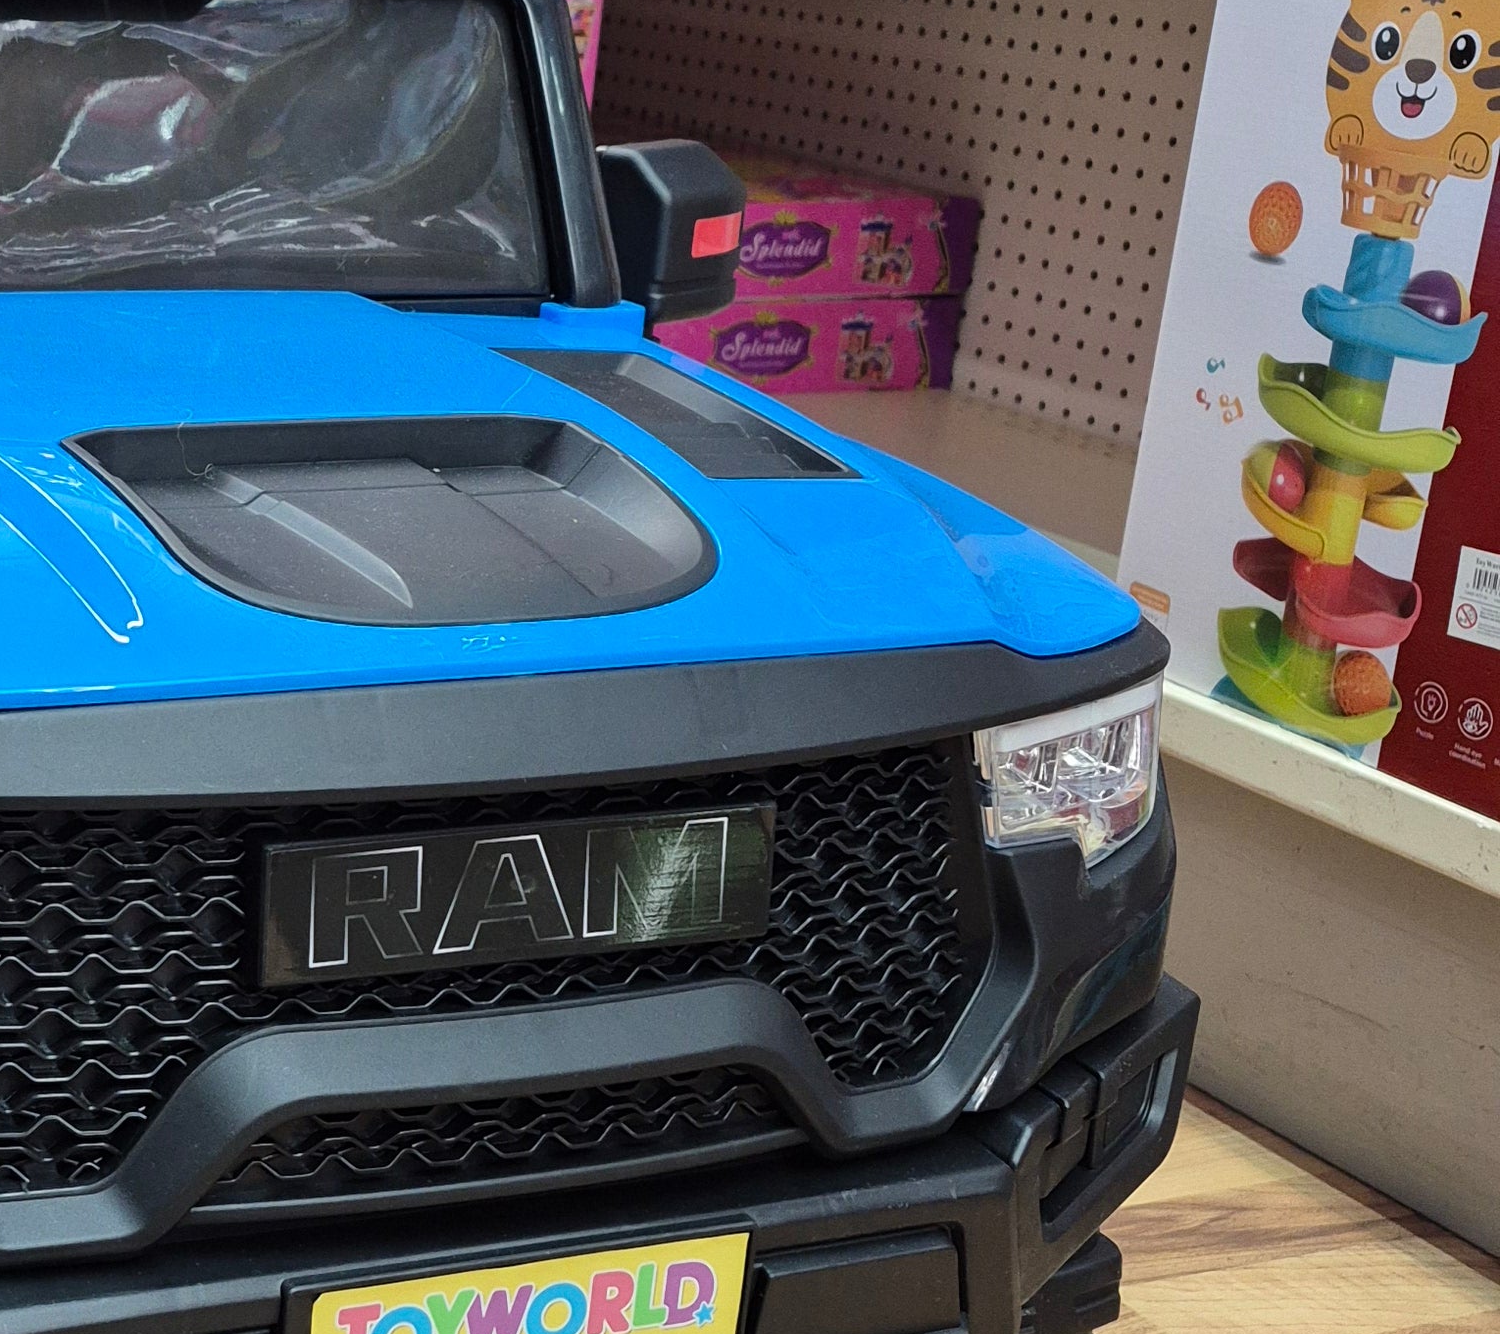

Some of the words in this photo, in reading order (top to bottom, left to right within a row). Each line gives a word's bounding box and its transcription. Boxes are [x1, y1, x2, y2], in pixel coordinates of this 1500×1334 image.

[739, 231, 823, 263] Splendid
[721, 331, 802, 362] Splendid
[308, 817, 730, 969] RAM
